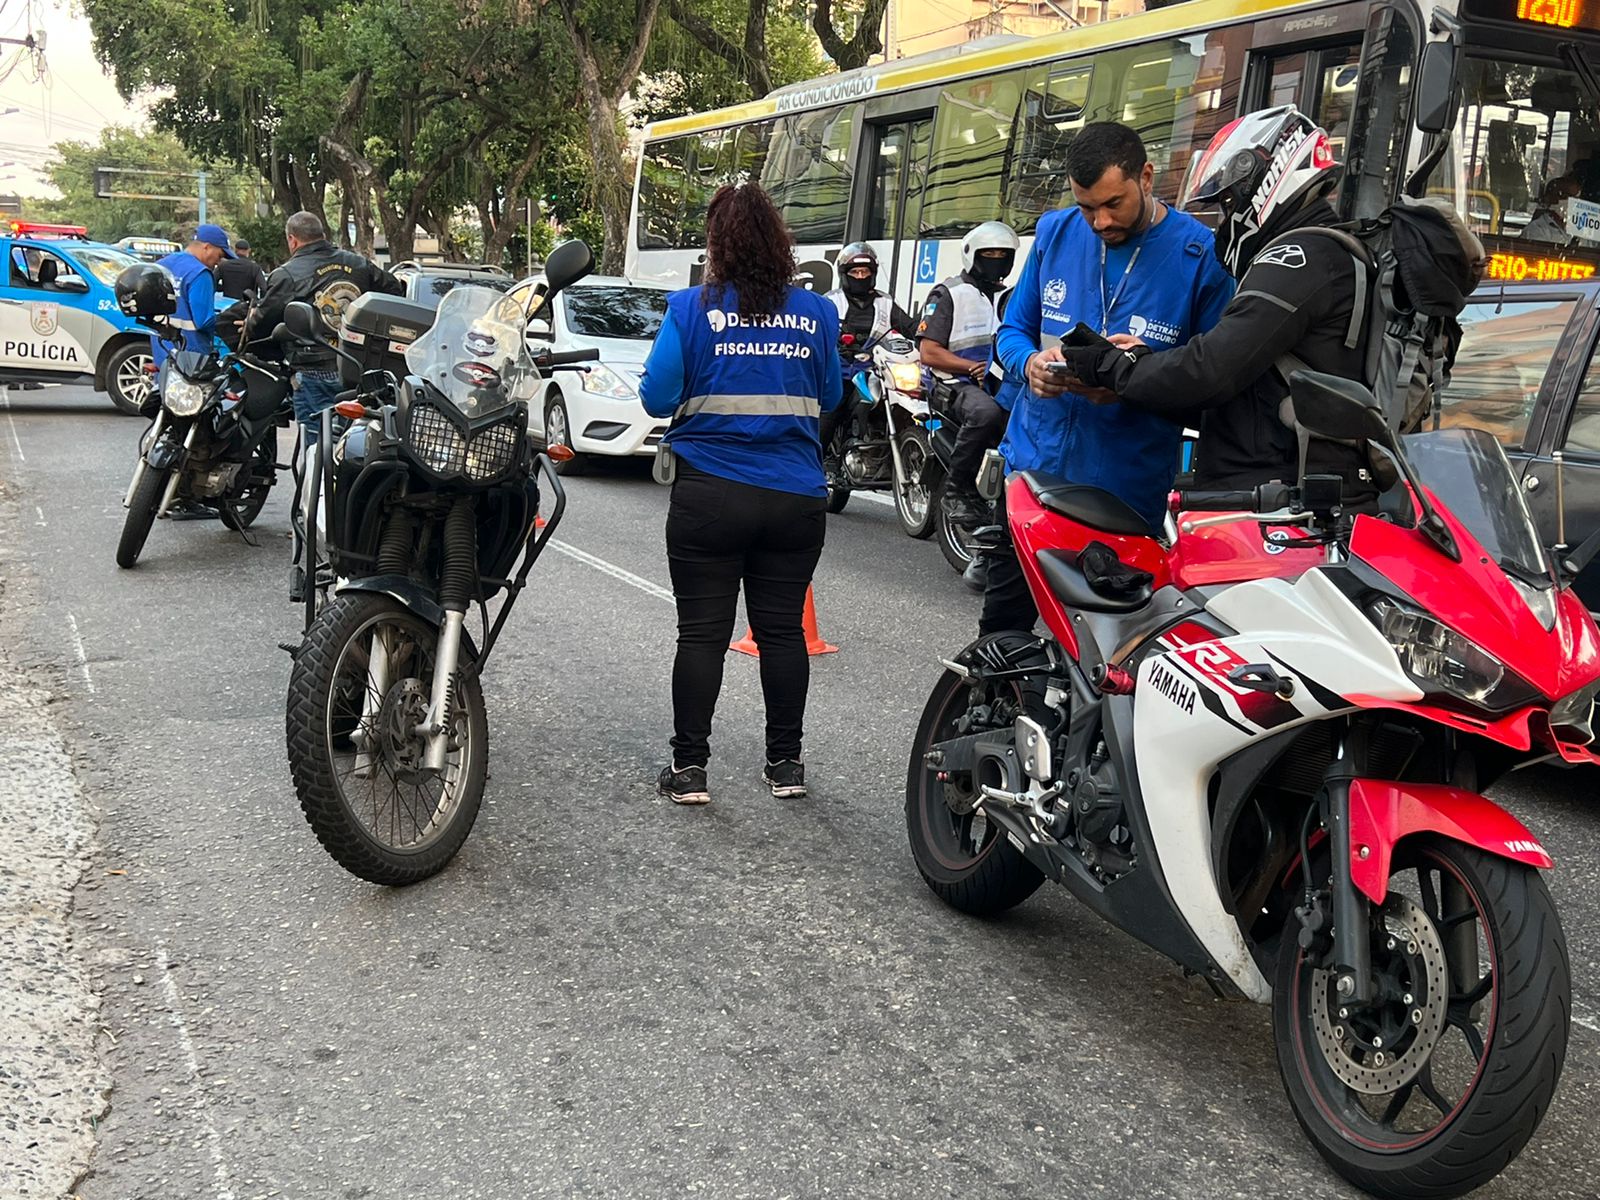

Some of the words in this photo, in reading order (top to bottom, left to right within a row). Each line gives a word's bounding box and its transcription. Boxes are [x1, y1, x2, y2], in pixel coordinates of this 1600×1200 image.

[778, 95, 790, 112] AR
[792, 76, 873, 107] CONDICIONADO
[1251, 125, 1307, 214] NORISK
[727, 312, 817, 334] DETRAN.RJ
[1147, 322, 1181, 337] DETRAN
[1143, 330, 1177, 345] SEGURO
[5, 340, 78, 362] POLÍCIA
[714, 342, 811, 360] FISCALIZAÇÃO
[1148, 660, 1197, 716] YAMAHA
